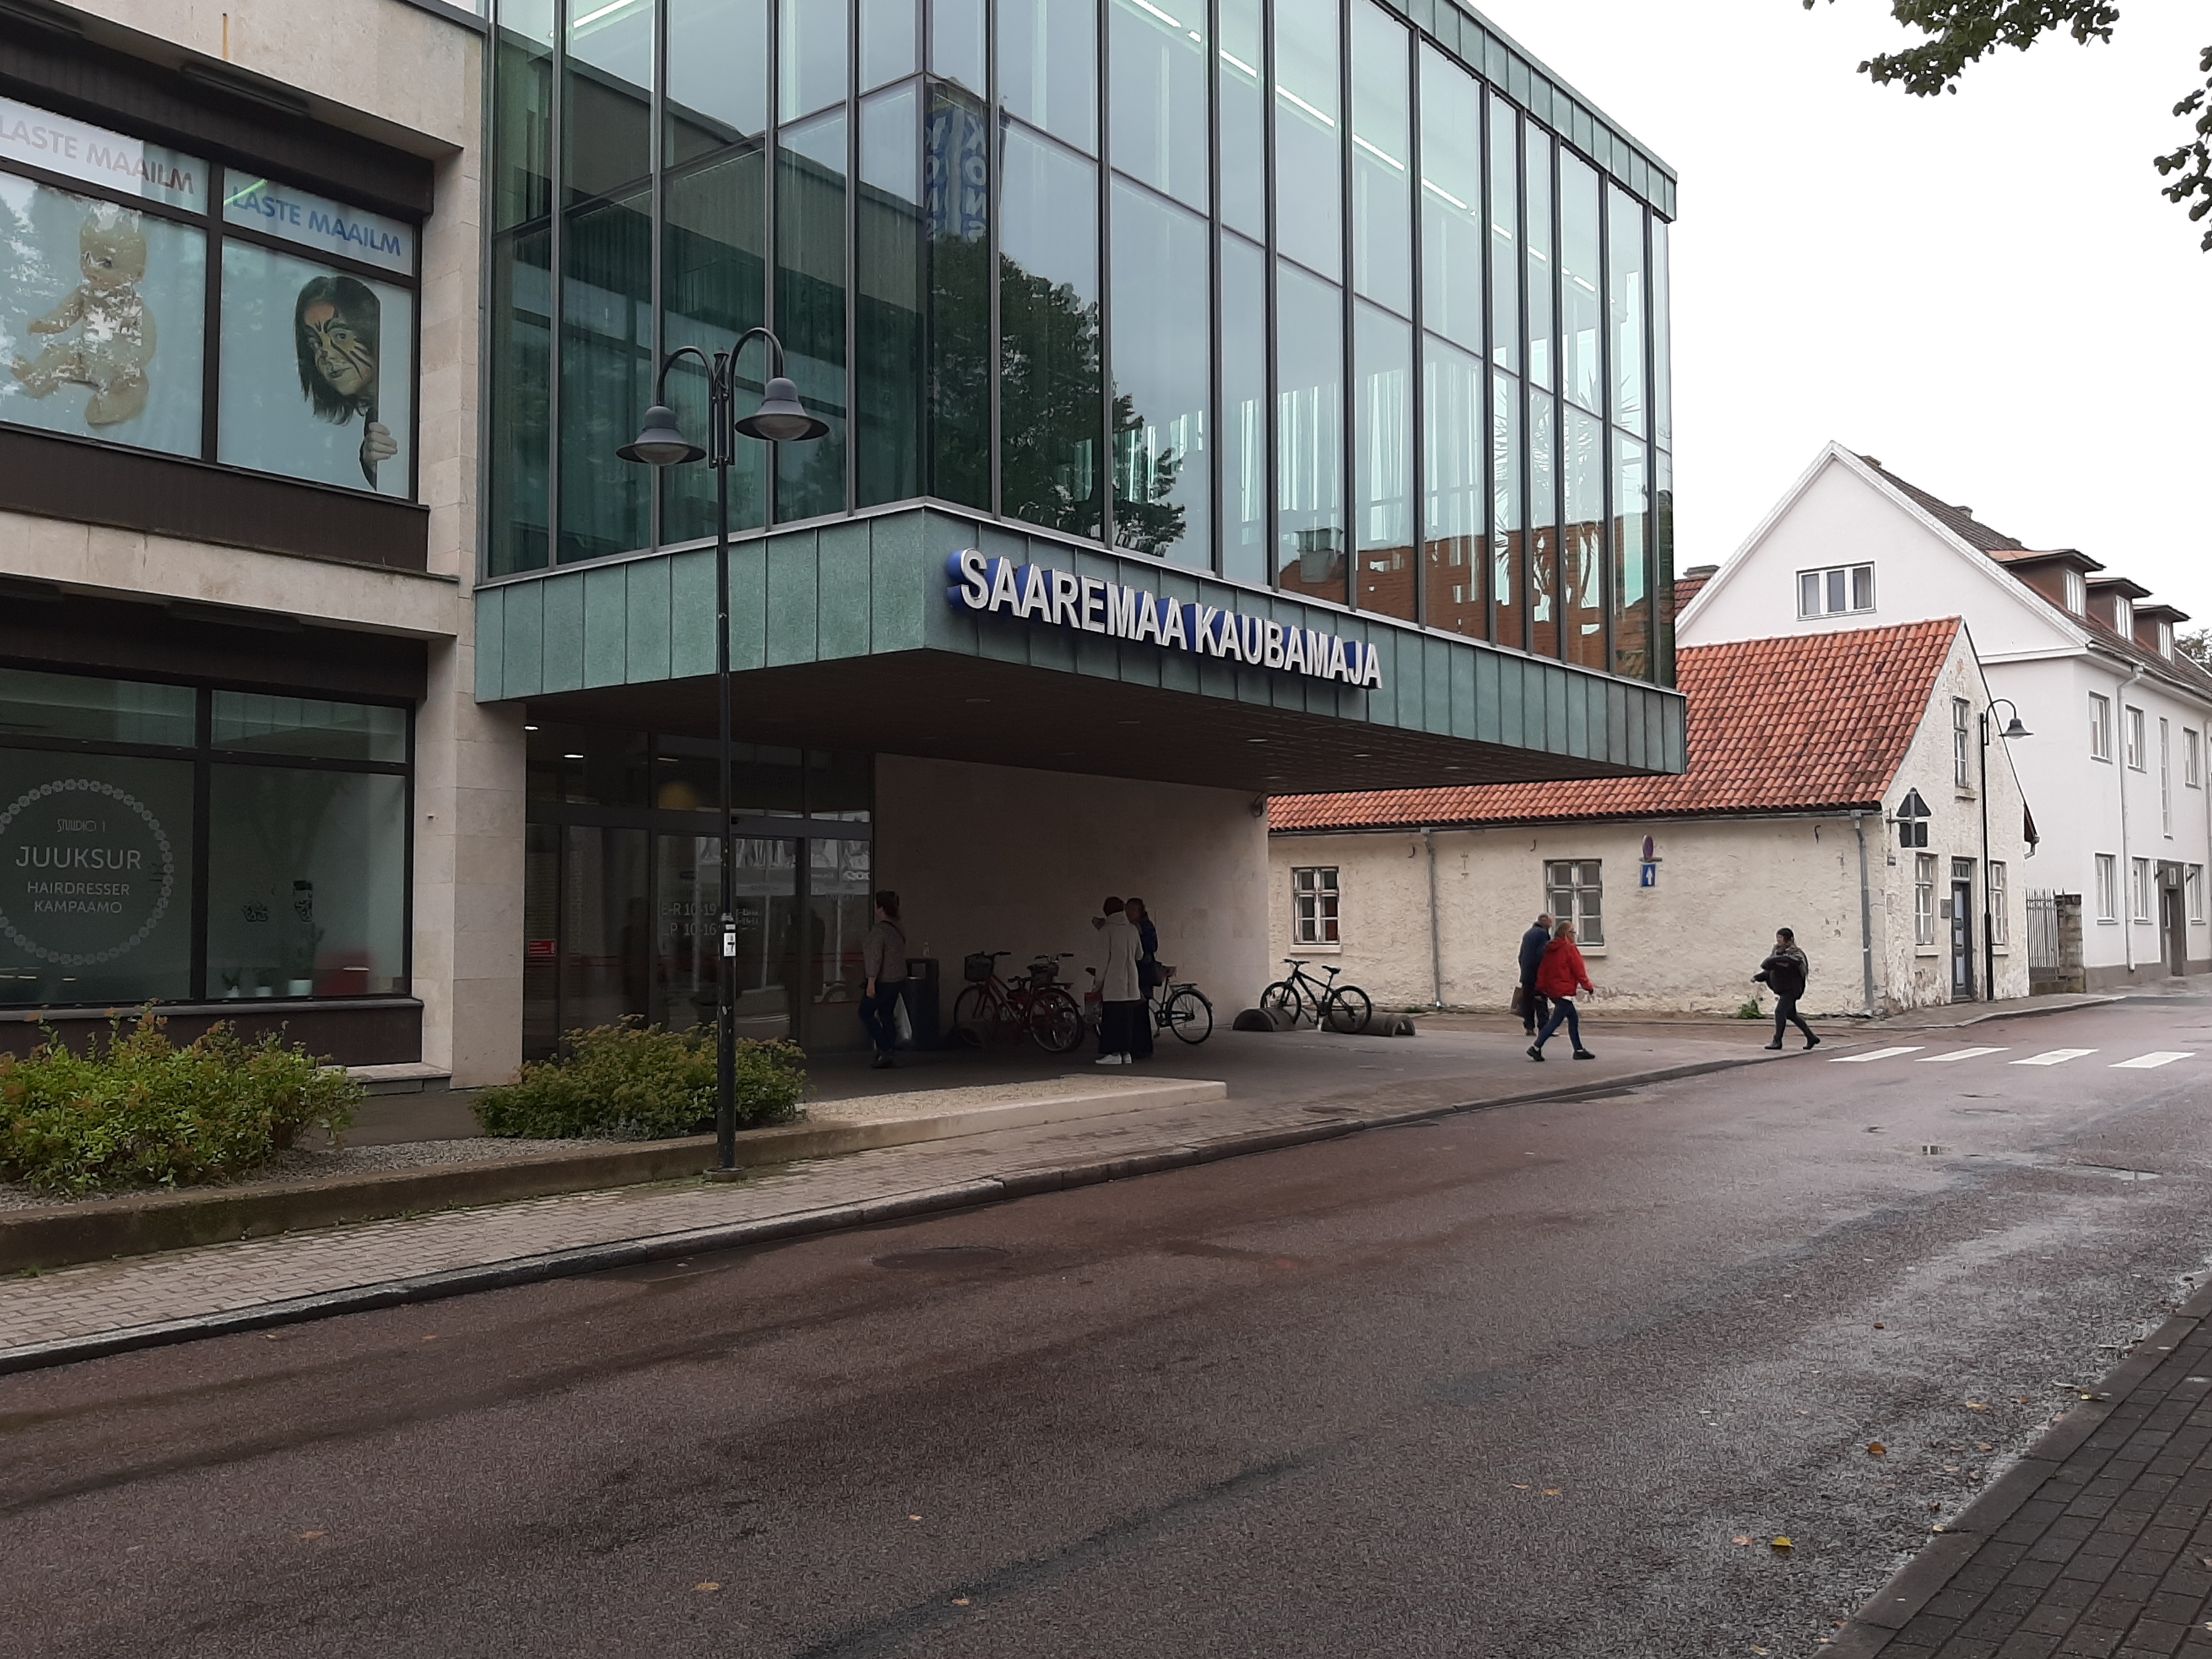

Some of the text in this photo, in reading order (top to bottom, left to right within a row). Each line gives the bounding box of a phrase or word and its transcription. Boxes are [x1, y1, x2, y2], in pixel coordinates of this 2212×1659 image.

[0, 115, 194, 195] LASTE MAAILM
[232, 186, 400, 256] LASTE MAAILM
[953, 547, 1383, 690] SAAREMAA KAUBAMAJA
[16, 846, 142, 870] JUUKSUR
[27, 880, 130, 896] HAIRDRESSER
[34, 900, 123, 914] KAMPAAMO
